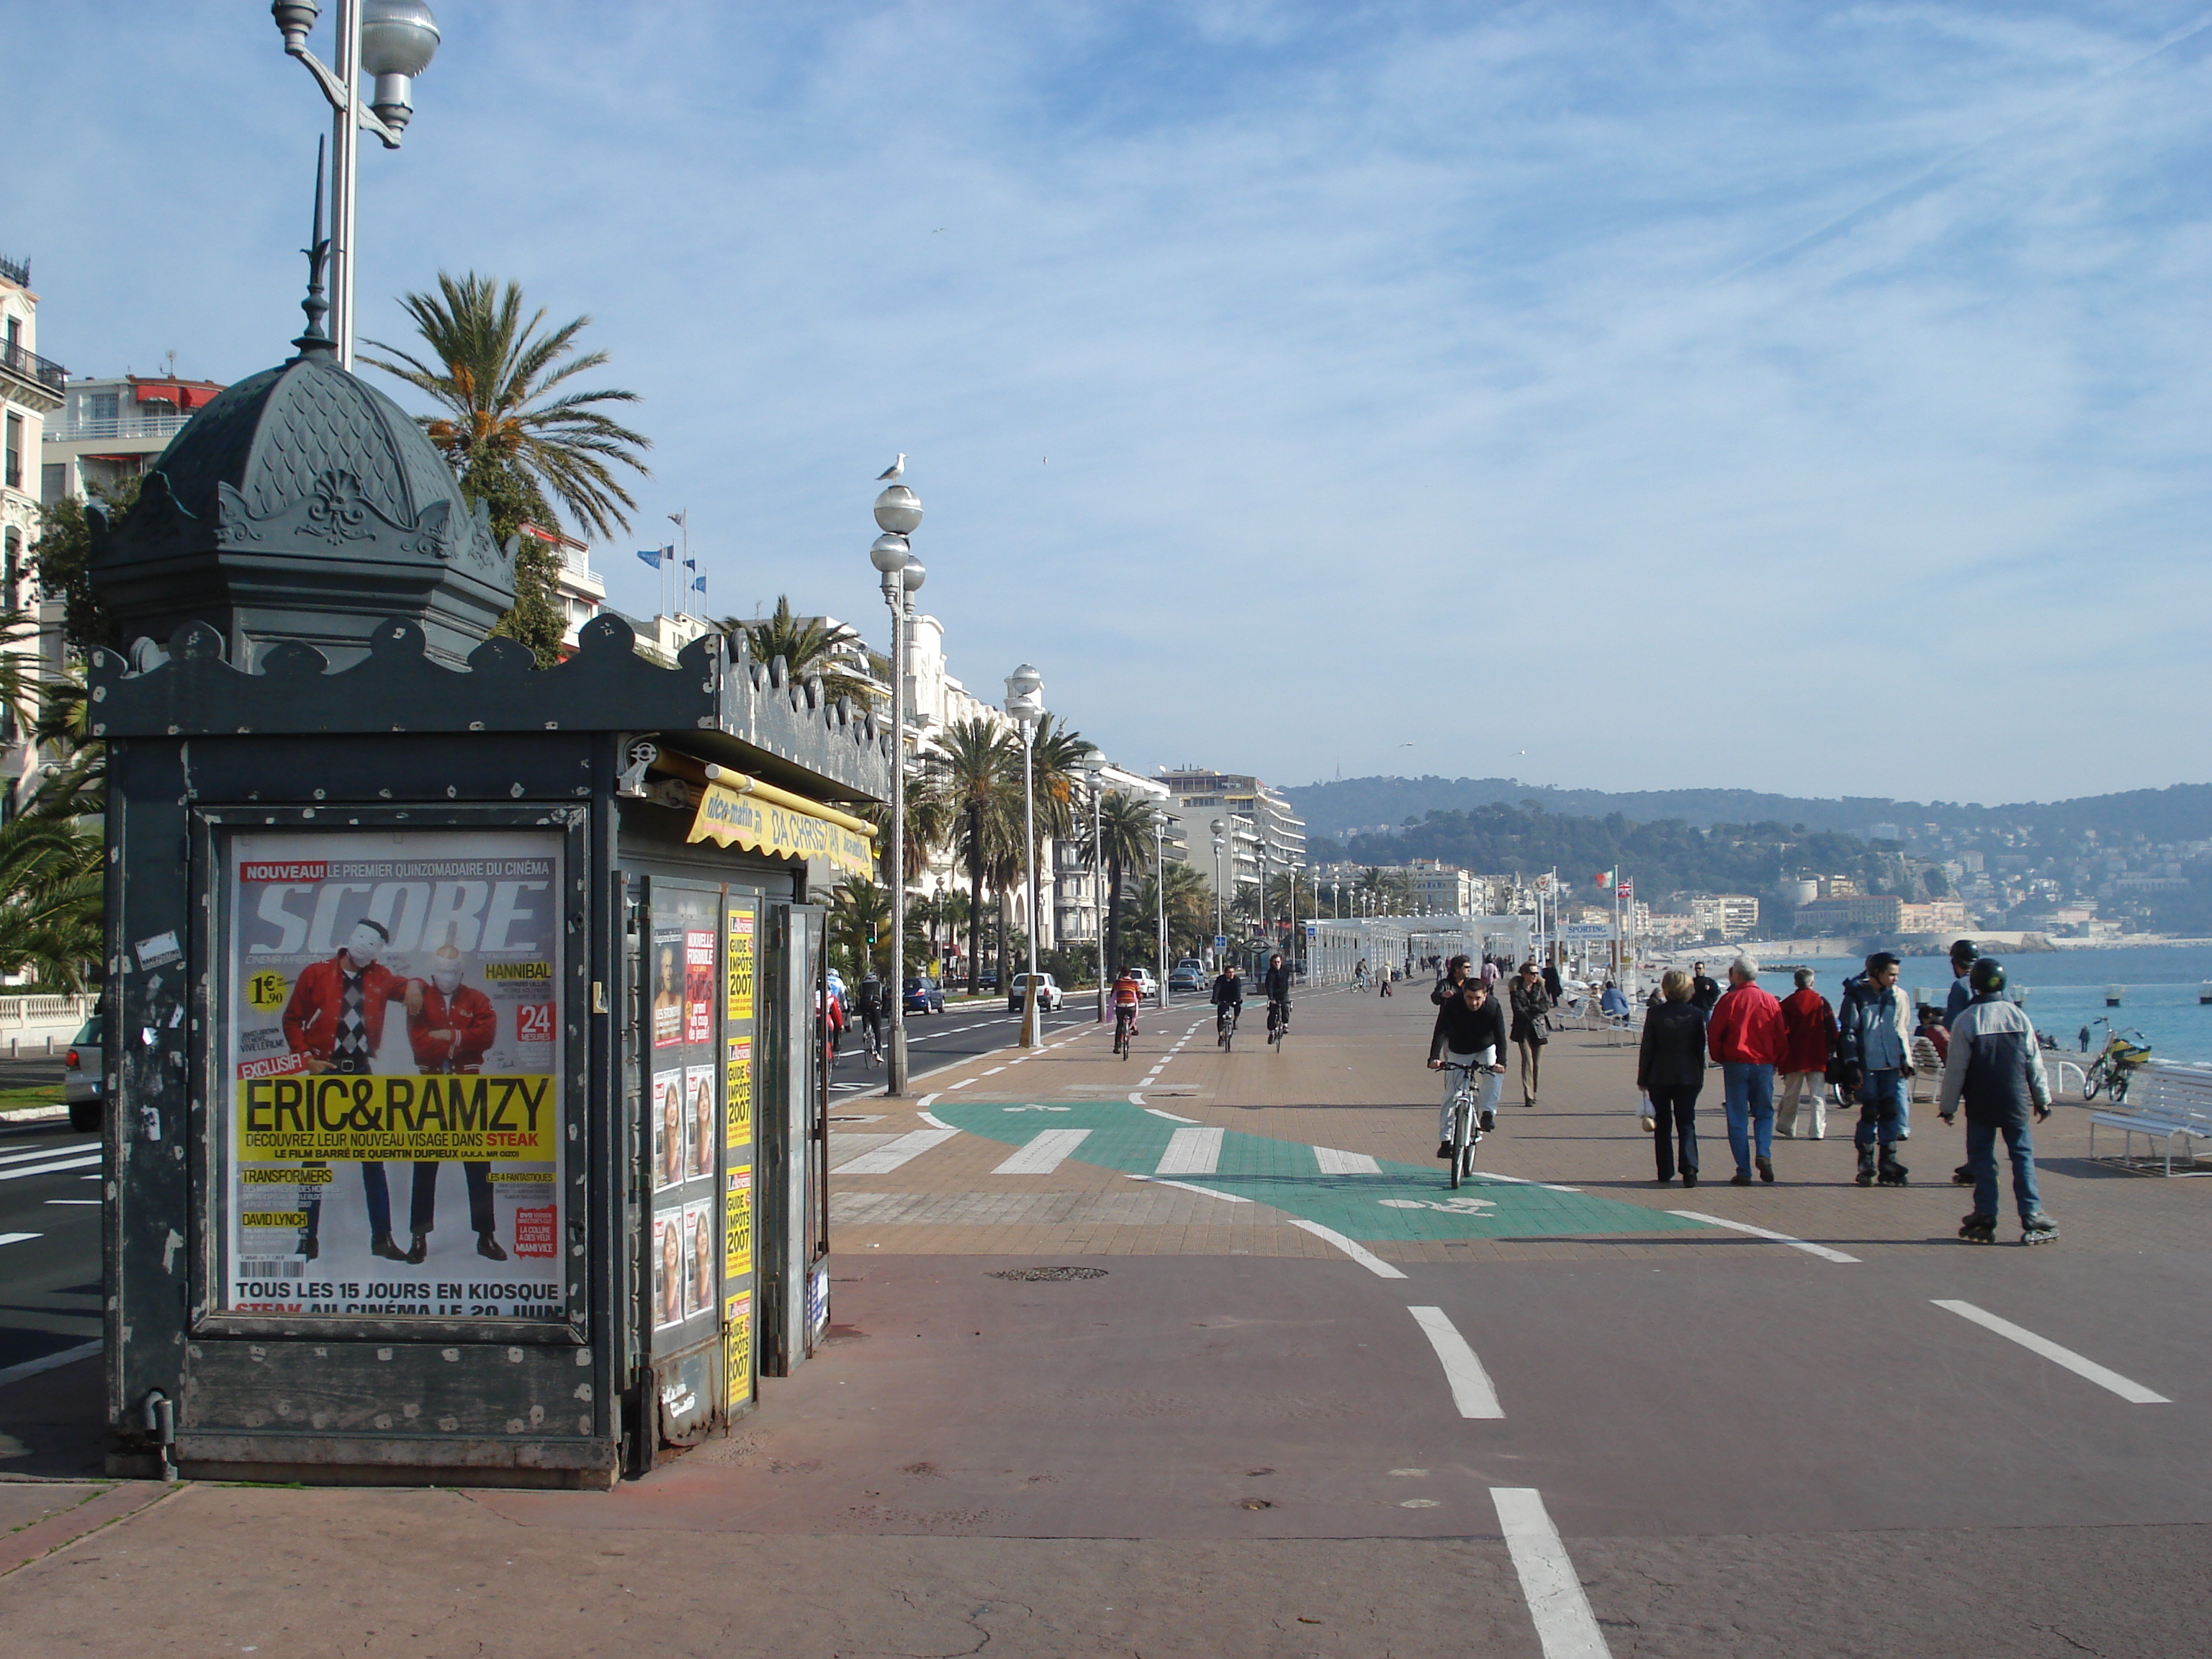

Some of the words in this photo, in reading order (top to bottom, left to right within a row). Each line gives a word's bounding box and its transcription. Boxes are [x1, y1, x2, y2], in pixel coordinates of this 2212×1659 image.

[706, 792, 752, 828] nice-matin
[772, 809, 788, 848] DA
[247, 865, 324, 879] NOUVEAU!
[328, 864, 340, 878] LE
[343, 864, 393, 878] PREMIER
[395, 862, 484, 878] QUINZOMADAIRE
[486, 862, 503, 876] DU
[505, 859, 549, 876] CINÉMA
[249, 880, 549, 955] SCORE
[688, 932, 714, 948] NOUVELLE
[729, 938, 747, 953] GUIDE
[687, 948, 713, 965] FORMULE
[729, 953, 753, 972] IMPÔTS
[485, 963, 552, 979] HANNIBAL
[729, 974, 752, 995] 2007
[521, 1005, 551, 1033] 24
[240, 1043, 257, 1053] VIVE
[257, 1041, 266, 1051] LE
[241, 1053, 302, 1079] EXCLUSIF!
[728, 1065, 745, 1081] GUIDE
[728, 1080, 750, 1100] IMPÔTS
[246, 1078, 549, 1133] ERIC&RAMZY
[728, 1100, 750, 1125] 2007
[318, 1133, 346, 1147] LEUR
[350, 1133, 404, 1147] NOUVEAU
[408, 1133, 449, 1146] VISAGE
[451, 1133, 483, 1146] DANS
[486, 1132, 539, 1147] STEAK
[274, 1149, 287, 1159] LE
[289, 1149, 313, 1159] FILM
[315, 1147, 351, 1159] BARRÉ
[353, 1149, 366, 1159] DE
[368, 1149, 412, 1159] QUENTIN
[414, 1149, 459, 1159] DUPIEUX
[243, 1169, 333, 1183] TRANSFORMERS
[487, 1172, 500, 1182] LES
[500, 1172, 505, 1181] 4
[505, 1172, 553, 1182] FANTASTIQUES
[727, 1194, 745, 1211] GUIDE
[243, 1213, 272, 1226] DAVID
[274, 1213, 306, 1226] LYNCH
[727, 1210, 750, 1231] IMPÔTS
[516, 1244, 538, 1252] MIAMI
[539, 1244, 553, 1252] VICE
[727, 1227, 750, 1254] 2007
[235, 1282, 291, 1298] TOUS
[297, 1282, 333, 1298] LES
[339, 1283, 359, 1298] 15
[365, 1283, 431, 1299] JOURS
[436, 1283, 462, 1299] EN
[468, 1283, 558, 1302] KIOSQUE
[732, 1321, 744, 1339] UIDE
